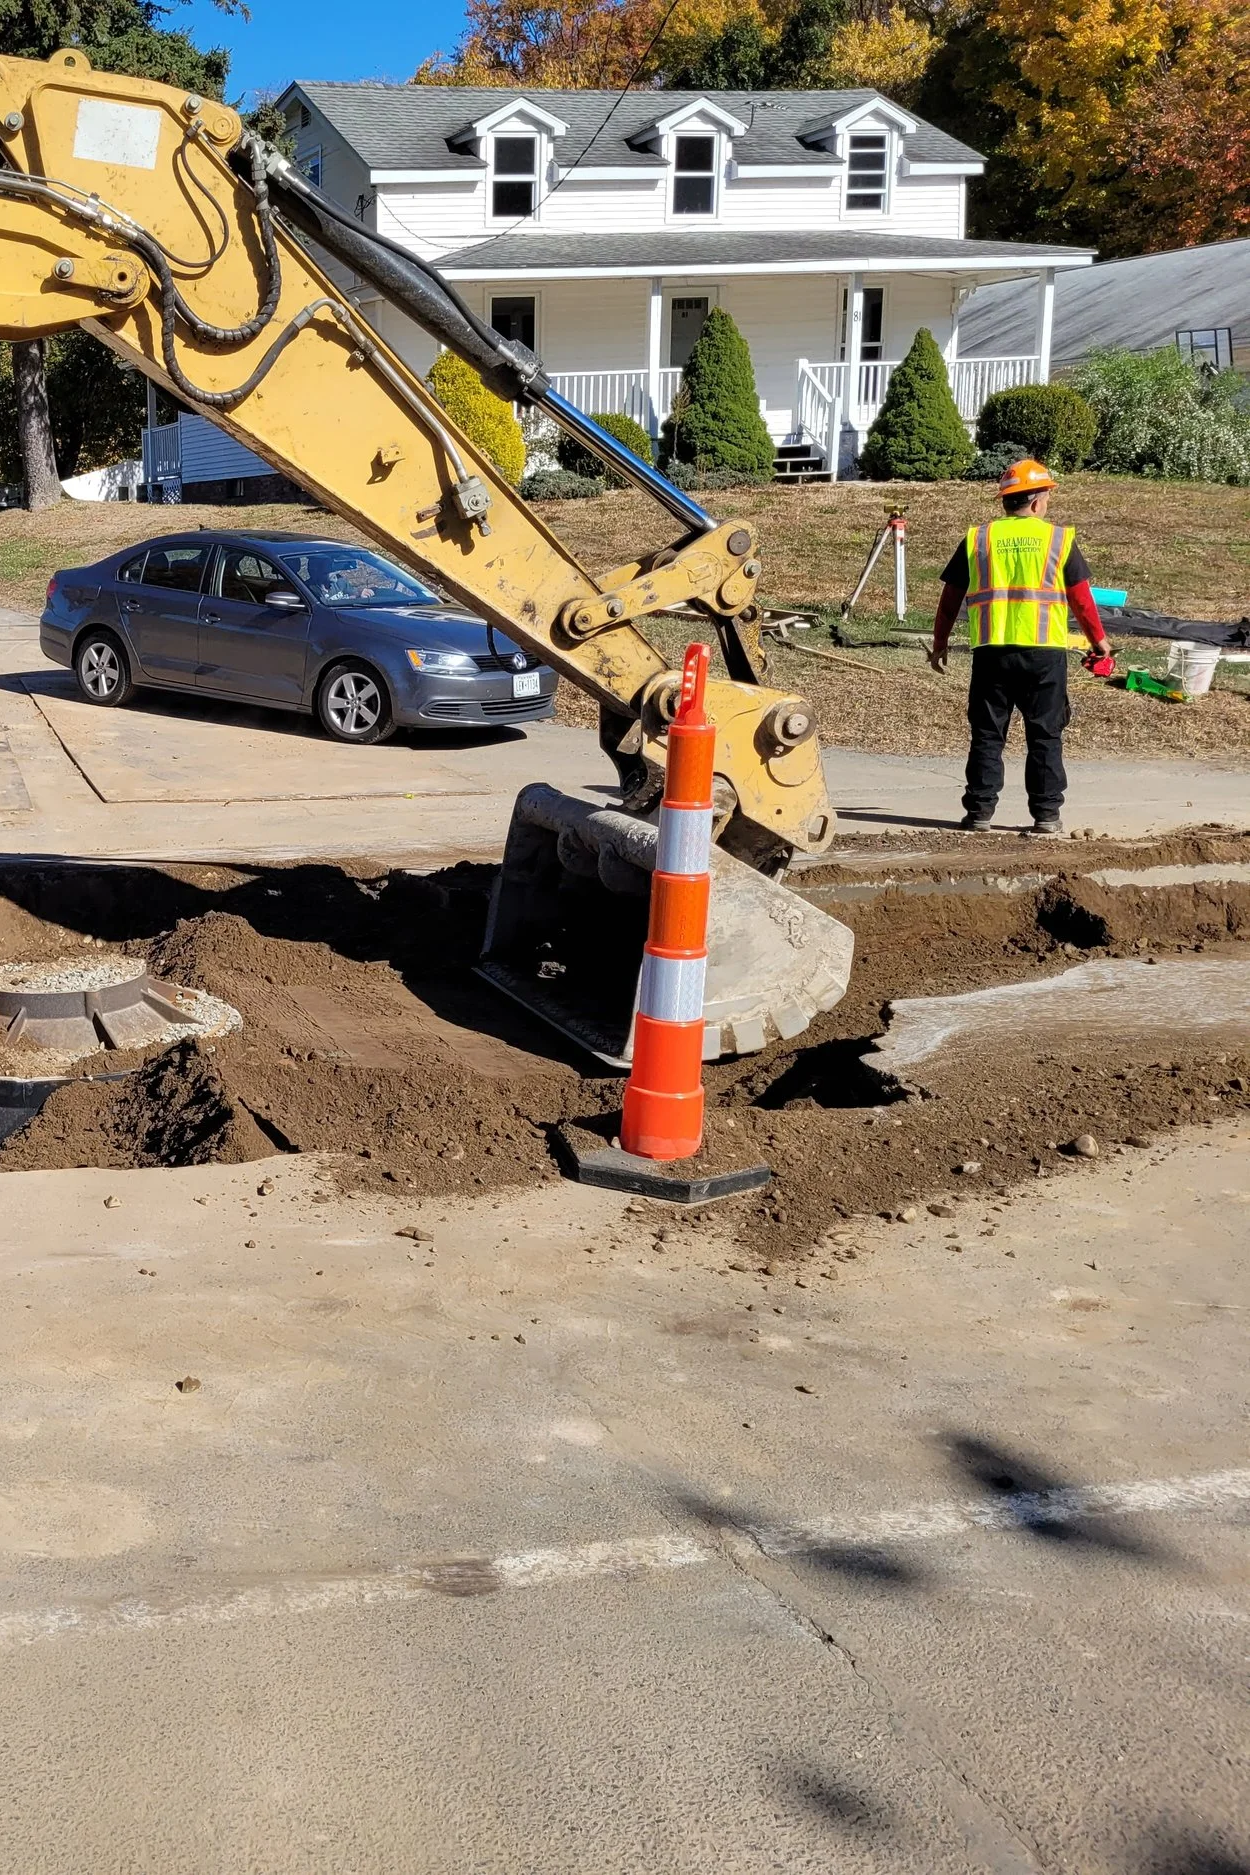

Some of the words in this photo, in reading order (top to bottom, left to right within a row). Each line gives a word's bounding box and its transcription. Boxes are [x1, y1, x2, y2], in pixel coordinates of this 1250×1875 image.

[853, 310, 862, 322] 81
[996, 536, 1043, 548] PARAMOUNT
[996, 547, 1041, 555] CONSTRUCTION
